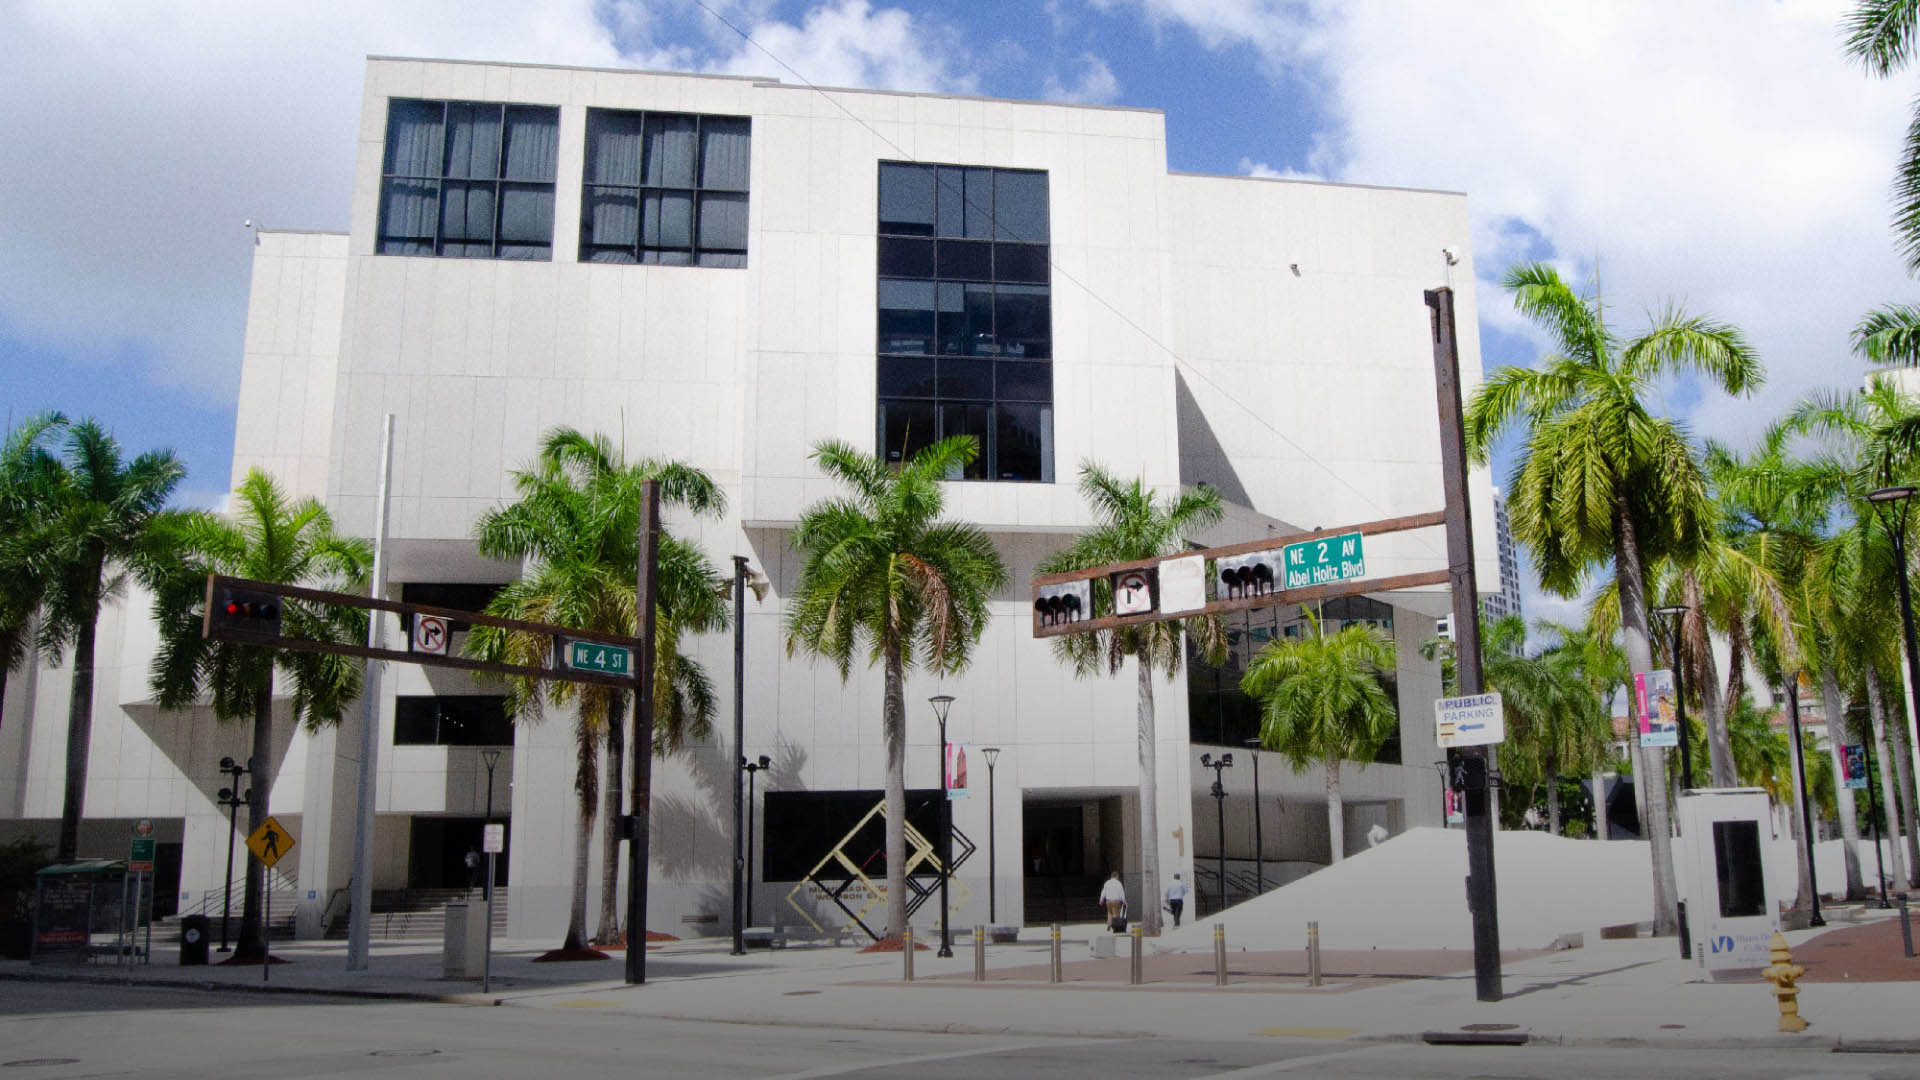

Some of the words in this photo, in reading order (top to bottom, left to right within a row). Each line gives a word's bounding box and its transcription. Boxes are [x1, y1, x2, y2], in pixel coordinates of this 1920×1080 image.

[1290, 548, 1305, 565] NE
[1317, 542, 1329, 563] 2
[1342, 538, 1355, 557] AV
[1289, 567, 1310, 587] Abel
[1312, 564, 1339, 582] Holtz
[1341, 558, 1364, 578] Blvd
[576, 648, 589, 664] NE
[594, 650, 606, 668] 4
[612, 653, 622, 668] ST
[1445, 695, 1493, 710] PUBLIC
[1443, 708, 1495, 721] PARKING
